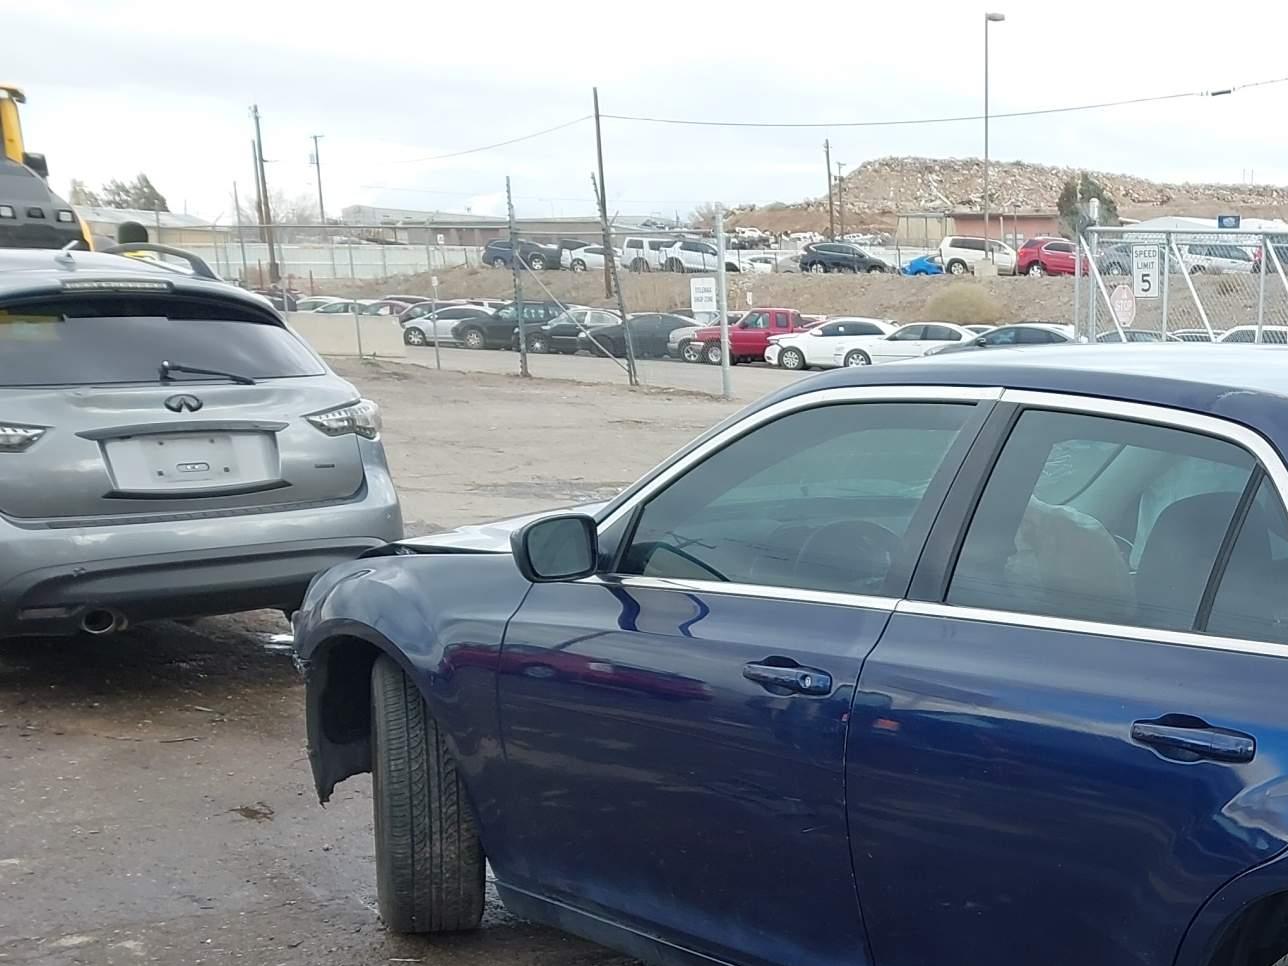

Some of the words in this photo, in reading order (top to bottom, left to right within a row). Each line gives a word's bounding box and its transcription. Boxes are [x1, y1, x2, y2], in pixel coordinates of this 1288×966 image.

[1135, 250, 1157, 258] SPEED
[1137, 262, 1154, 270] LIMIT
[1141, 274, 1151, 292] 5
[1114, 300, 1132, 311] STOP
